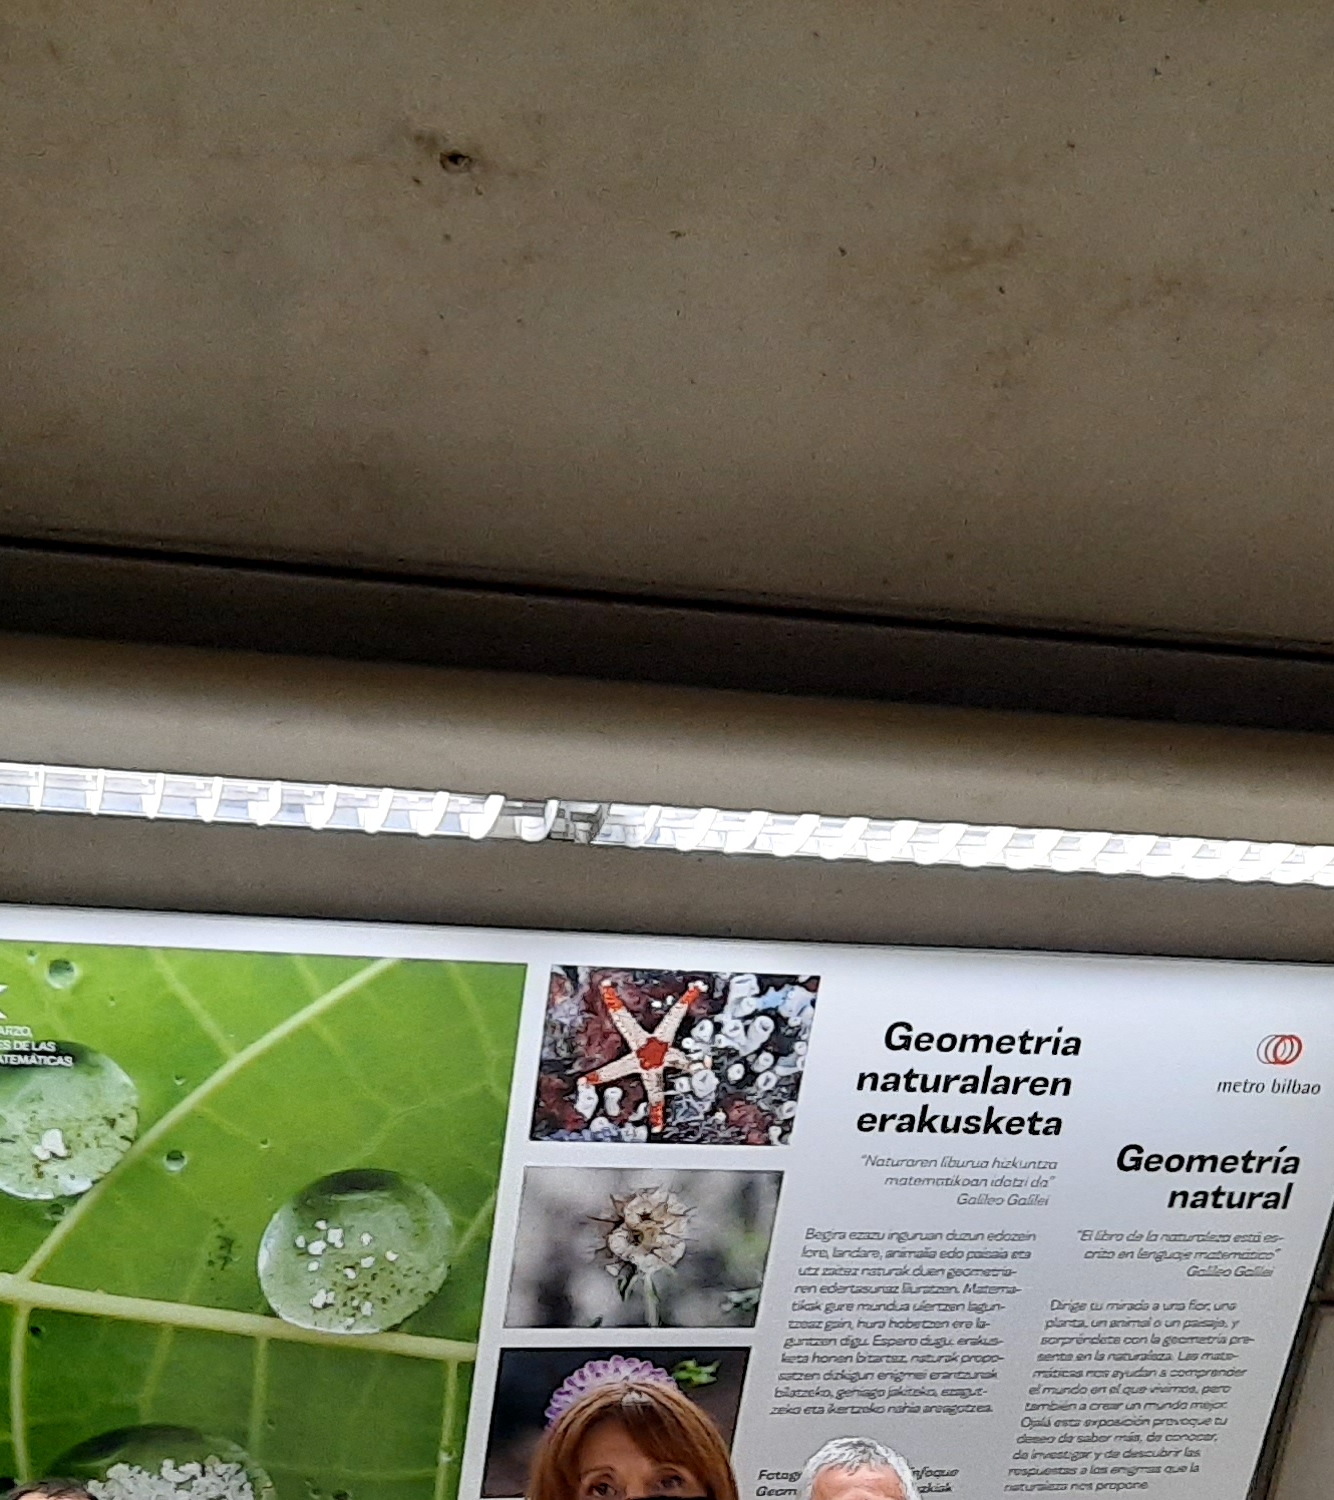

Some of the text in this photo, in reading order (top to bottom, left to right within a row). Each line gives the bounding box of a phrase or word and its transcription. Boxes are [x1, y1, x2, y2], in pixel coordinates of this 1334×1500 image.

[884, 1021, 1083, 1056] Geometria
[14, 1040, 32, 1050] DE
[31, 1041, 57, 1052] LAS
[856, 1064, 1072, 1097] naturalaren
[1216, 1077, 1322, 1095] metro bilbao
[856, 1103, 1063, 1136] erakusketa
[940, 1155, 989, 1169] liburua
[991, 1157, 1059, 1170] hizkuntza
[1116, 1143, 1301, 1175] Geometría
[883, 1175, 988, 1187] matematikoan
[990, 1175, 1028, 1188] idatzi
[956, 1193, 1051, 1206] Galileo Galilei
[1166, 1181, 1295, 1210] natural
[805, 1228, 846, 1243] Begira
[887, 1229, 943, 1243] inguruan
[946, 1229, 985, 1241] duzun
[987, 1229, 1036, 1241] edozein
[1094, 1229, 1124, 1241] libro
[1126, 1230, 1145, 1242] de
[1145, 1230, 1158, 1242] la
[1160, 1231, 1232, 1243] naturaleza
[885, 1246, 937, 1258] animalia
[939, 1247, 964, 1258] edo
[1010, 1250, 1032, 1259] eta
[1117, 1250, 1134, 1259] en
[860, 1264, 911, 1276] naturak
[913, 1264, 944, 1276] duen
[794, 1285, 817, 1294] ren
[824, 1302, 854, 1314] gure
[857, 1299, 909, 1311] mundua
[1050, 1299, 1087, 1313] Dirige
[1106, 1299, 1149, 1311] mirada
[1163, 1302, 1186, 1311] una
[1214, 1302, 1238, 1311] una
[1109, 1316, 1153, 1328] animal
[871, 1334, 918, 1347] Espero
[1123, 1336, 1148, 1345] con
[810, 1351, 853, 1363] honen
[1177, 1351, 1200, 1361] Las
[1085, 1370, 1110, 1378] nos
[1111, 1366, 1157, 1380] ayudan
[1042, 1383, 1088, 1395] mundo
[1122, 1386, 1147, 1396] que
[1201, 1385, 1232, 1395] pero
[803, 1406, 825, 1415] eta
[1143, 1399, 1188, 1410] mundo
[1163, 1465, 1188, 1475] que
